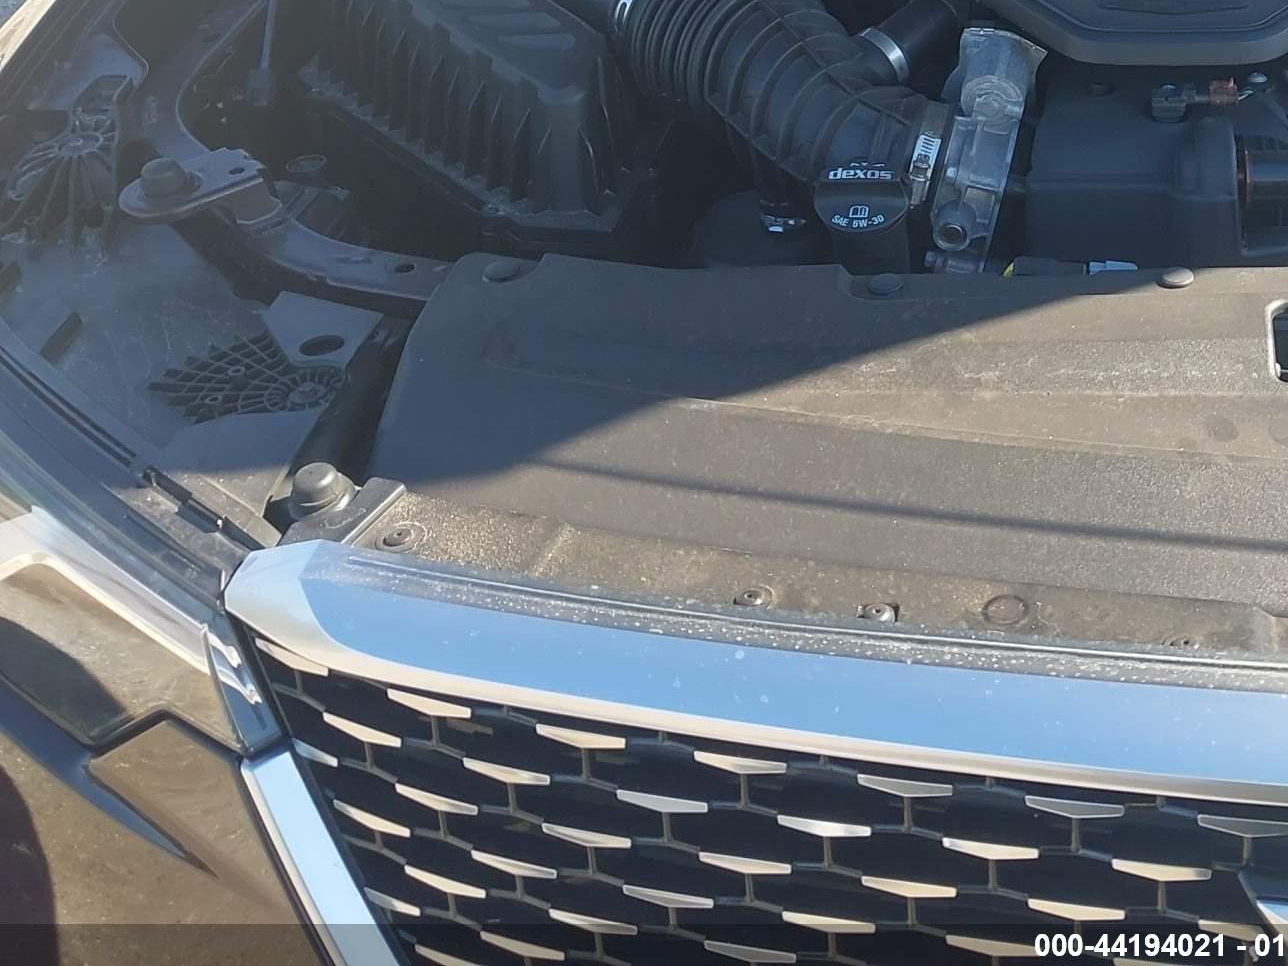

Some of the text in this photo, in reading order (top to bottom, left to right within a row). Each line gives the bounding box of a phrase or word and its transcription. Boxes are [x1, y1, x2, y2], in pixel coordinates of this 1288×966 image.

[828, 167, 893, 180] dexos
[831, 214, 885, 228] SAE 5W-30
